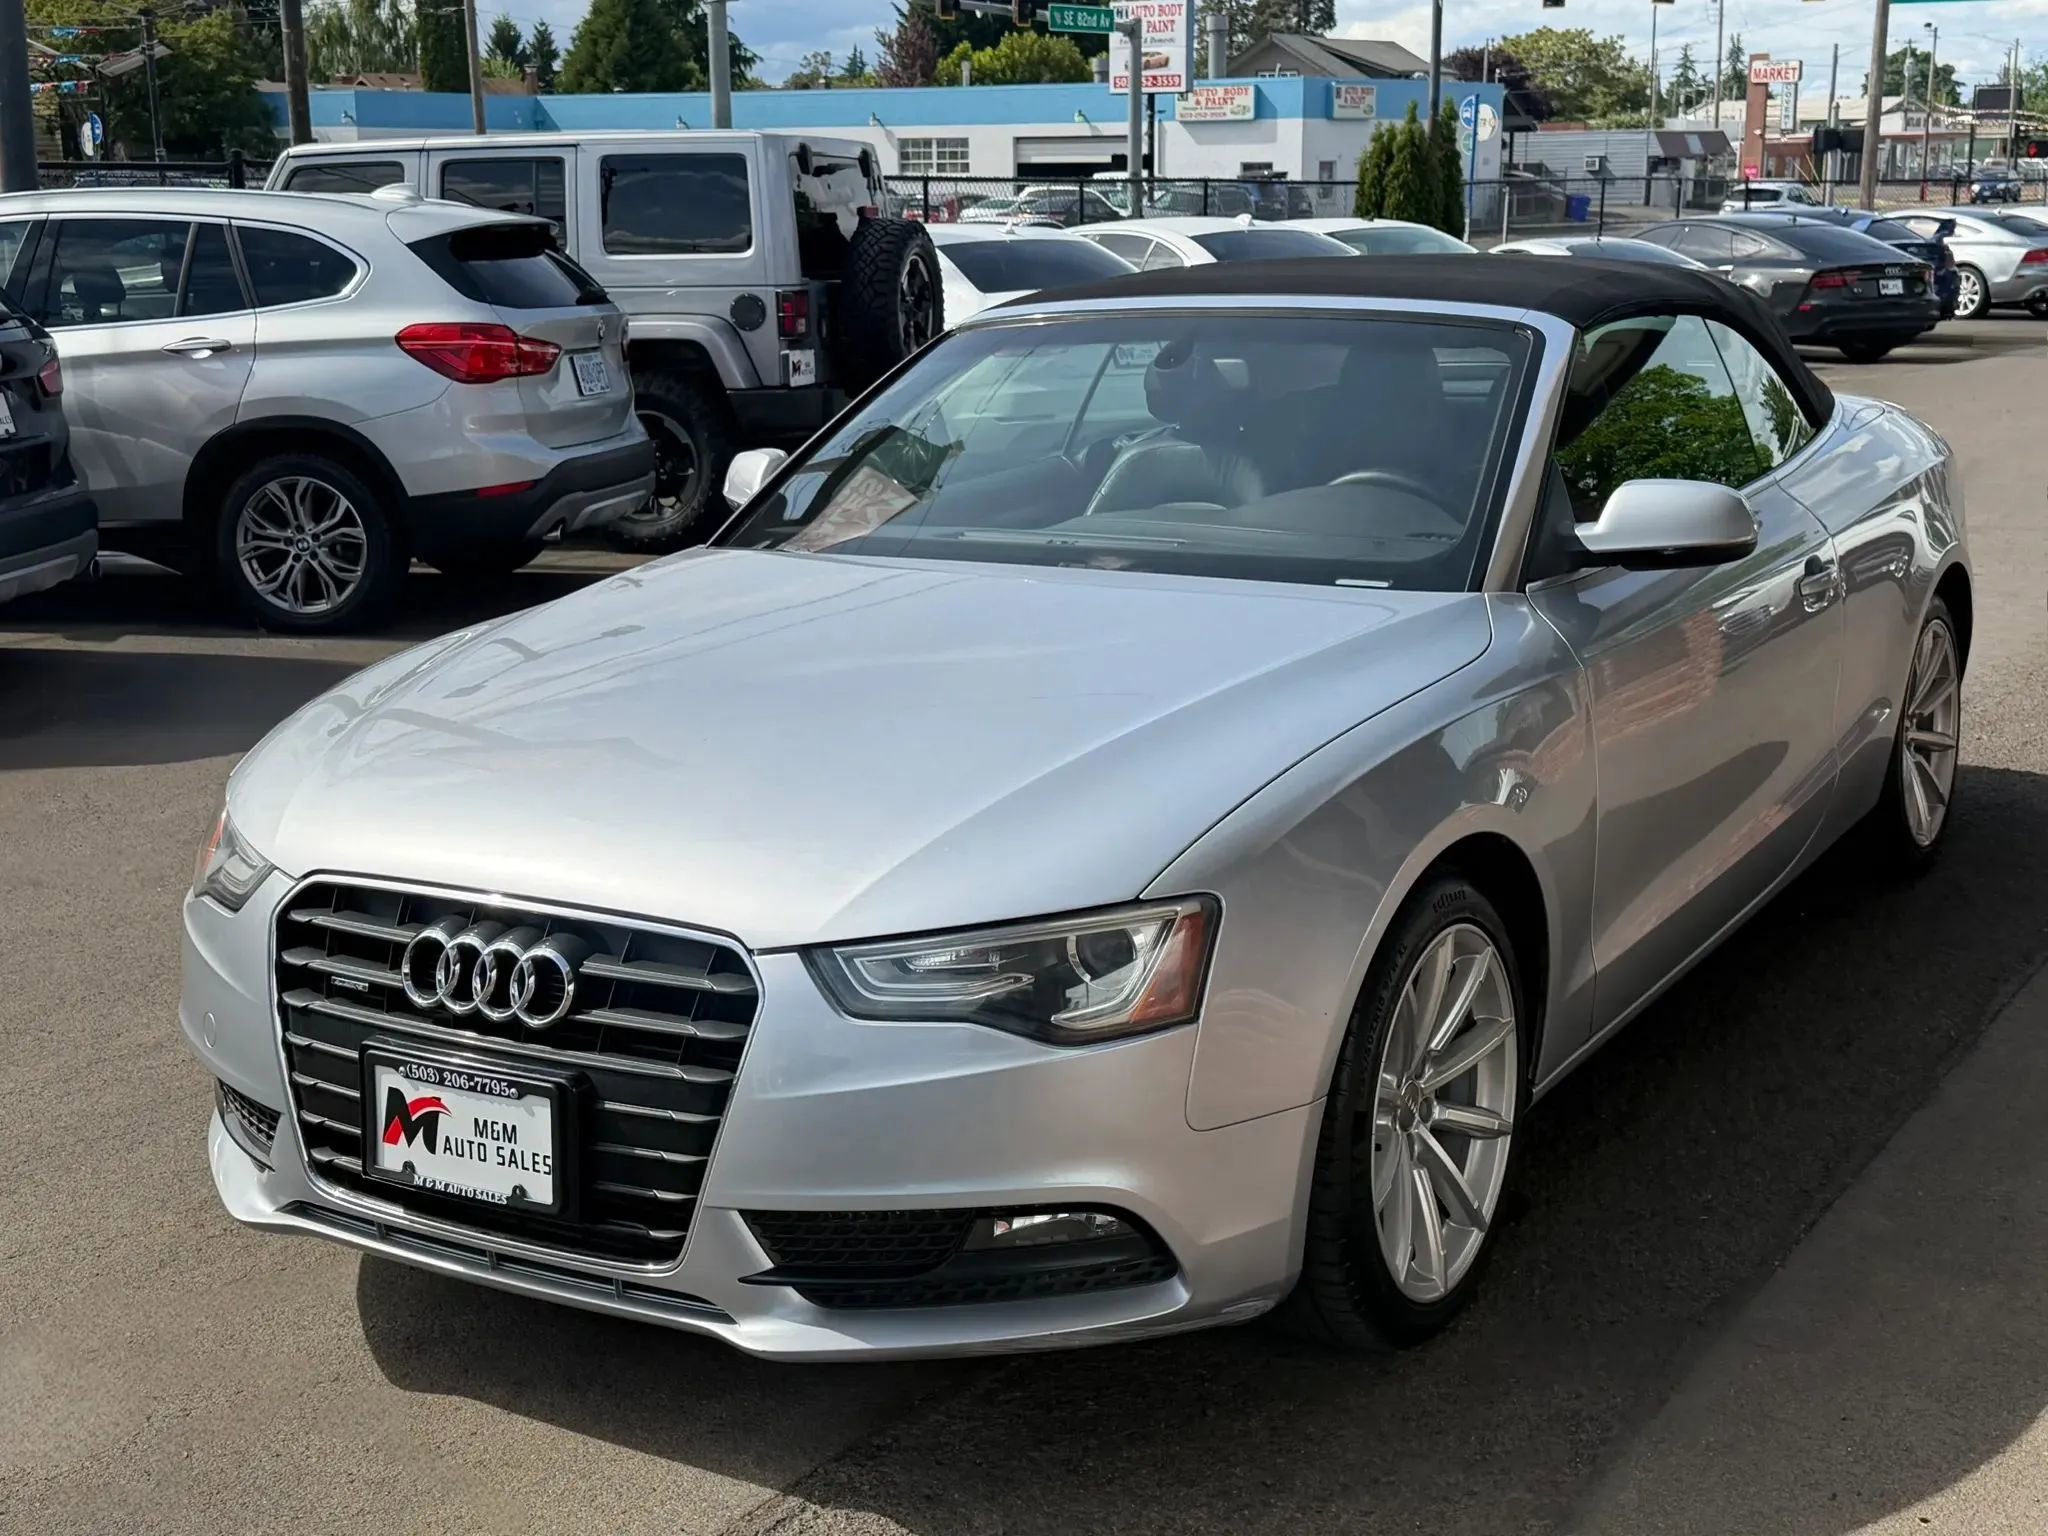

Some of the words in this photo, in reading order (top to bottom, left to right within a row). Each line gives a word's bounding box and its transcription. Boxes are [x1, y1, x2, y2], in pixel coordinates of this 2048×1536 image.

[1130, 5, 1155, 17] AUTO
[1158, 4, 1184, 17] BODY
[1063, 10, 1074, 26] SE
[1077, 11, 1097, 27] 82nd
[1100, 13, 1111, 28] Av
[1146, 20, 1176, 33] PAINT
[1753, 67, 1798, 80] MARKET
[1193, 88, 1218, 97] AUTO
[1223, 87, 1250, 96] BODY
[1205, 97, 1235, 106] PAINT
[406, 1063, 440, 1084] (503)
[443, 1071, 509, 1097] 206-7795
[474, 1117, 517, 1145] M&M
[443, 1135, 487, 1163] AUTO
[496, 1146, 551, 1176] SALES
[446, 1181, 475, 1198] AUTO
[475, 1188, 508, 1205] SALES
